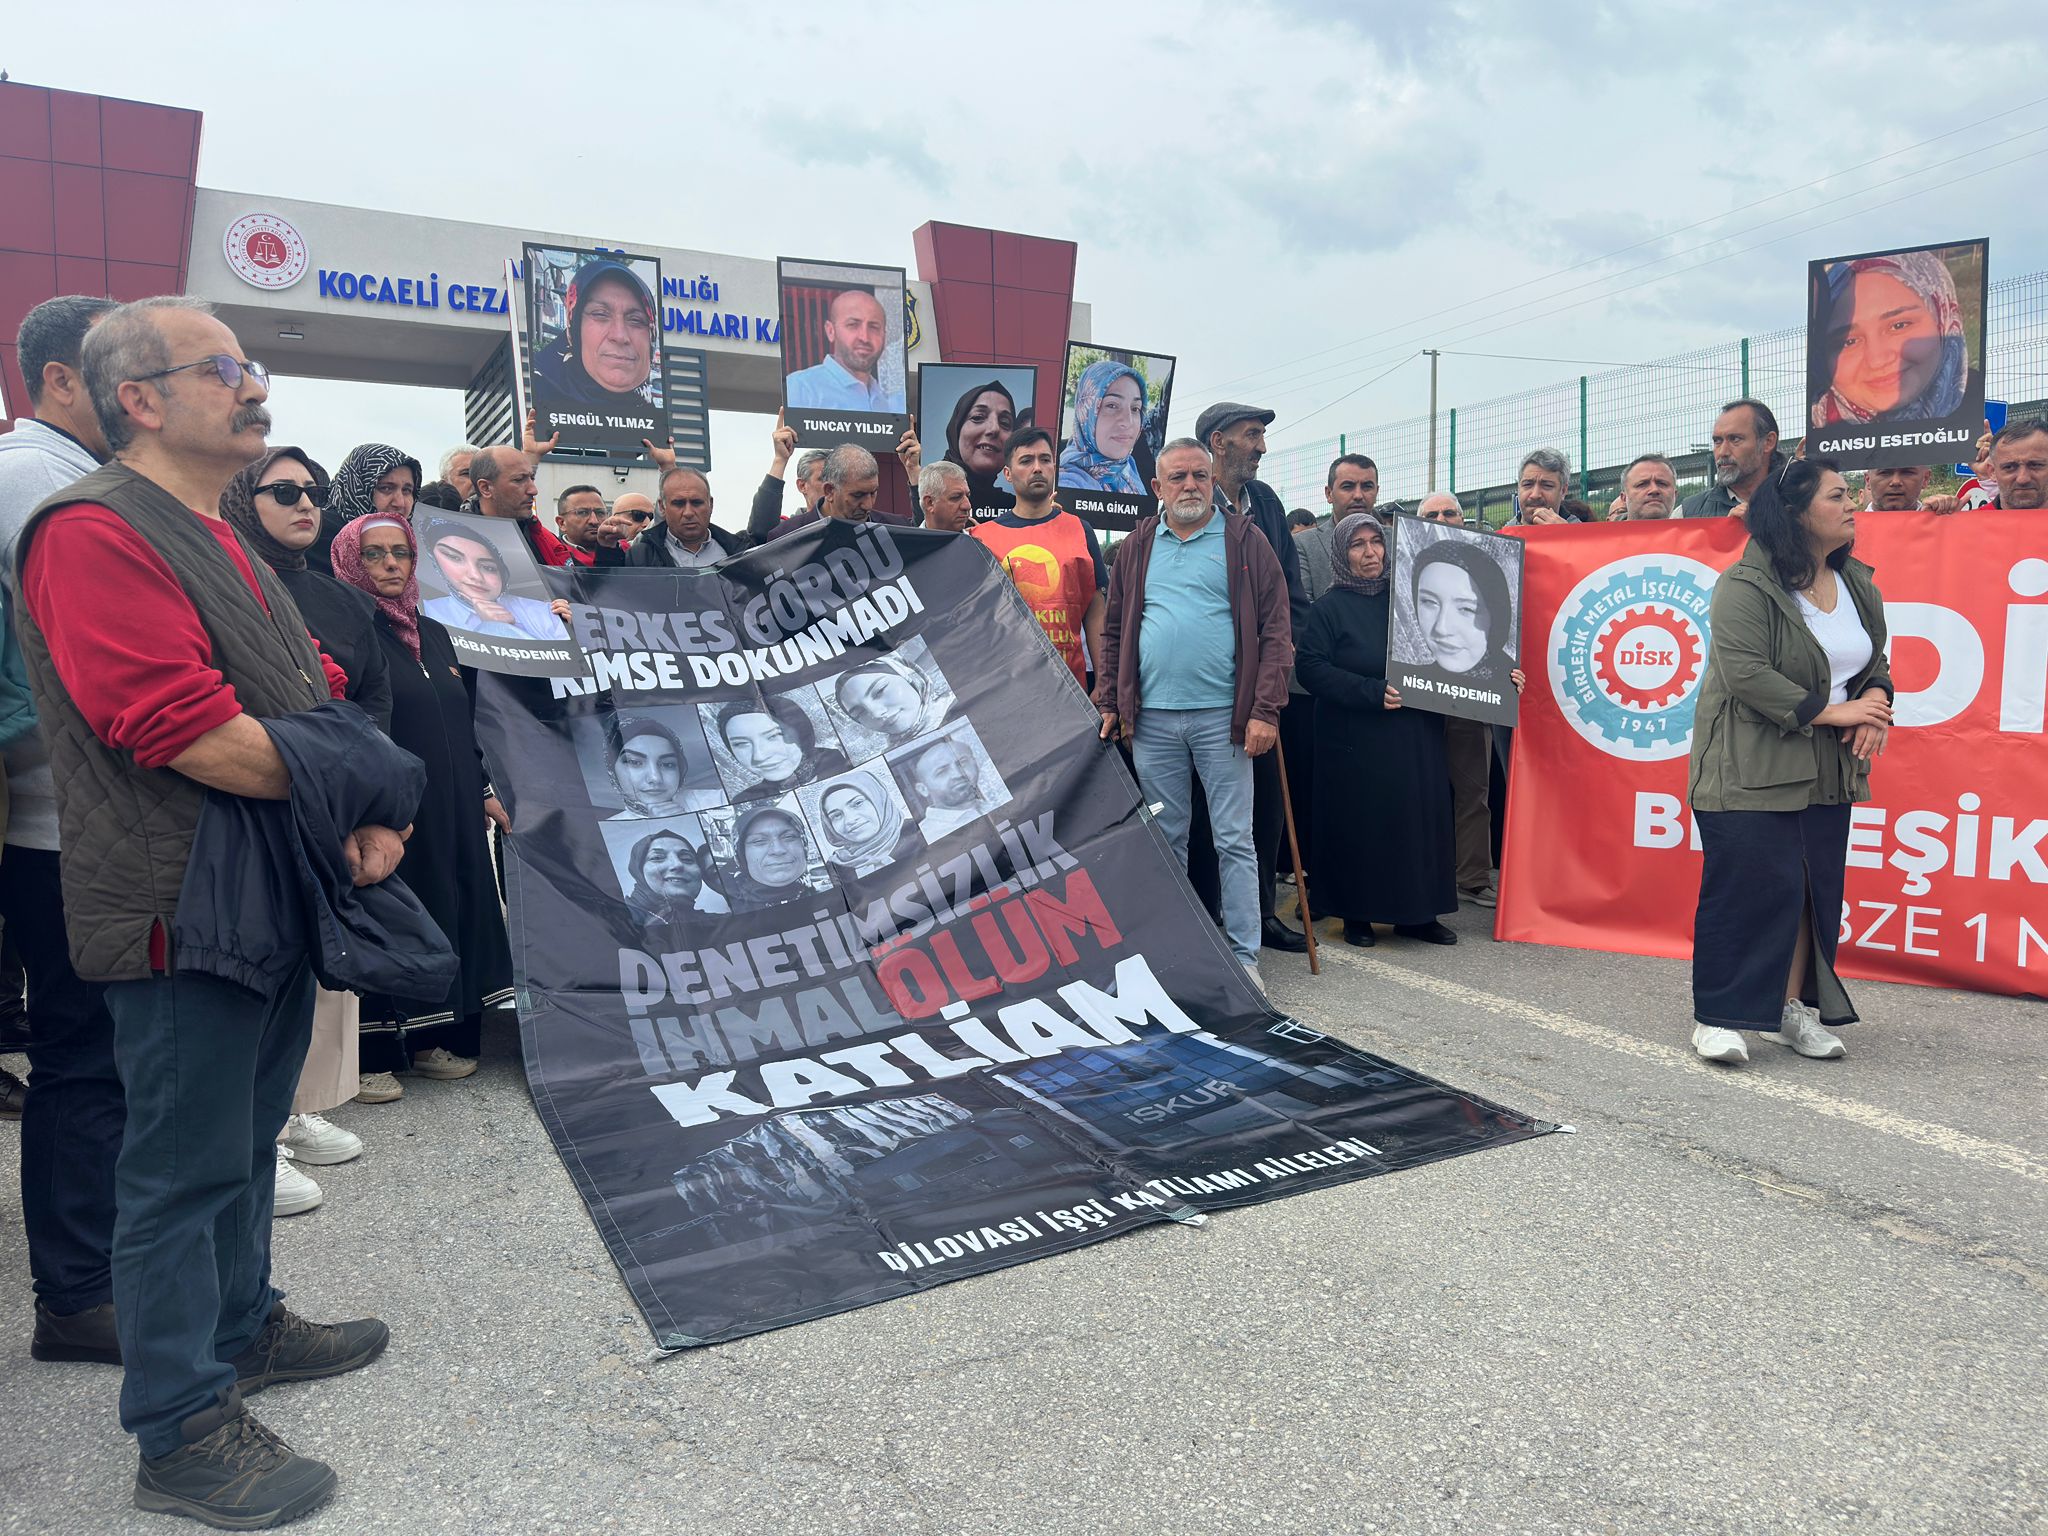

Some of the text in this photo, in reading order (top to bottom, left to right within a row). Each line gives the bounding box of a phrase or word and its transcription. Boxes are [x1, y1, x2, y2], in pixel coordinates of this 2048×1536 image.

[318, 269, 440, 309] KOCAELİ
[662, 306, 750, 340] UMLARI
[662, 274, 720, 302] NLIĞI
[549, 412, 655, 430] ŞENGÜL YILMAZ
[803, 419, 894, 435] TUNCAY YILDIZ
[1818, 427, 1969, 453] CANSU ESETOĞLU
[1075, 499, 1139, 516] ESMA GİKAN
[570, 521, 906, 655] ERKES GÖRDÜ
[1583, 585, 1636, 626] METAL
[450, 635, 572, 661] UĞBA TAŞDEMİR
[686, 574, 925, 689] DOKUNMADI
[1571, 628, 1598, 705] BİRLEŞİK
[1619, 641, 1675, 667] DİSK
[1402, 674, 1502, 705] NİSA TAŞDEMİR
[1620, 716, 1668, 733] 1947
[618, 810, 1080, 1007] DENETİMSİZLİK
[1963, 912, 1988, 963] 1
[628, 867, 1123, 1076] İHMAL ÖLÜM
[650, 953, 1202, 1128] KATLİAM
[1035, 1198, 1117, 1233] İŞÇİ
